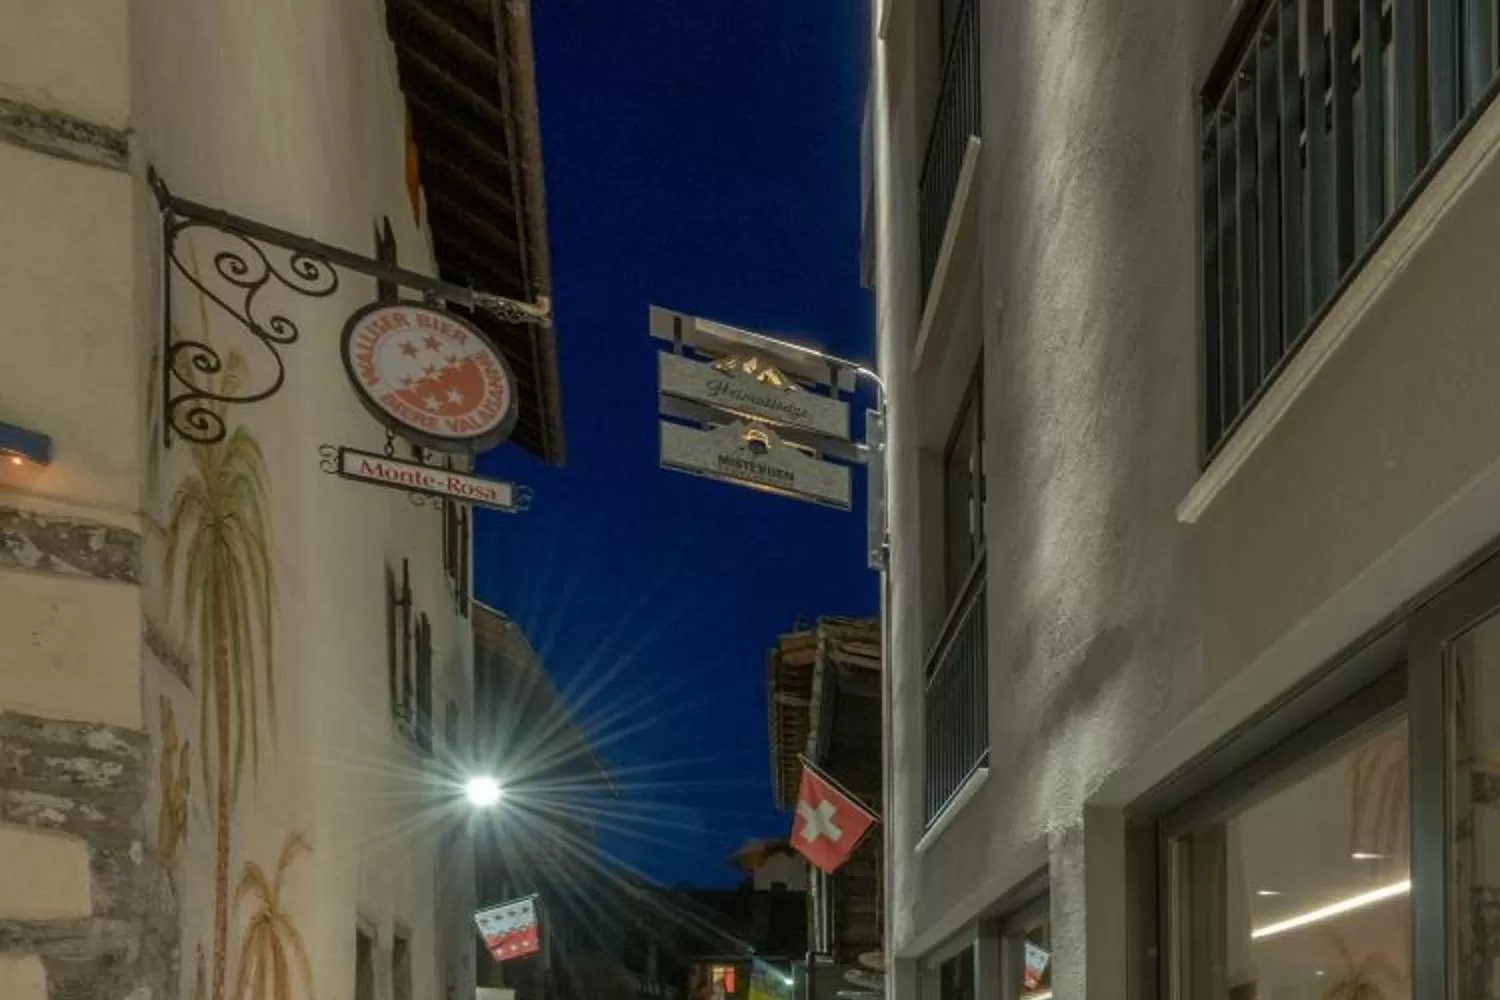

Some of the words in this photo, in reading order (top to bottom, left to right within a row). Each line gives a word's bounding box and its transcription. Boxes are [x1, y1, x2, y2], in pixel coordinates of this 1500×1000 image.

[355, 312, 411, 386] WALLISER
[416, 313, 468, 347] BIER
[359, 459, 497, 501] Monte-Rosa
